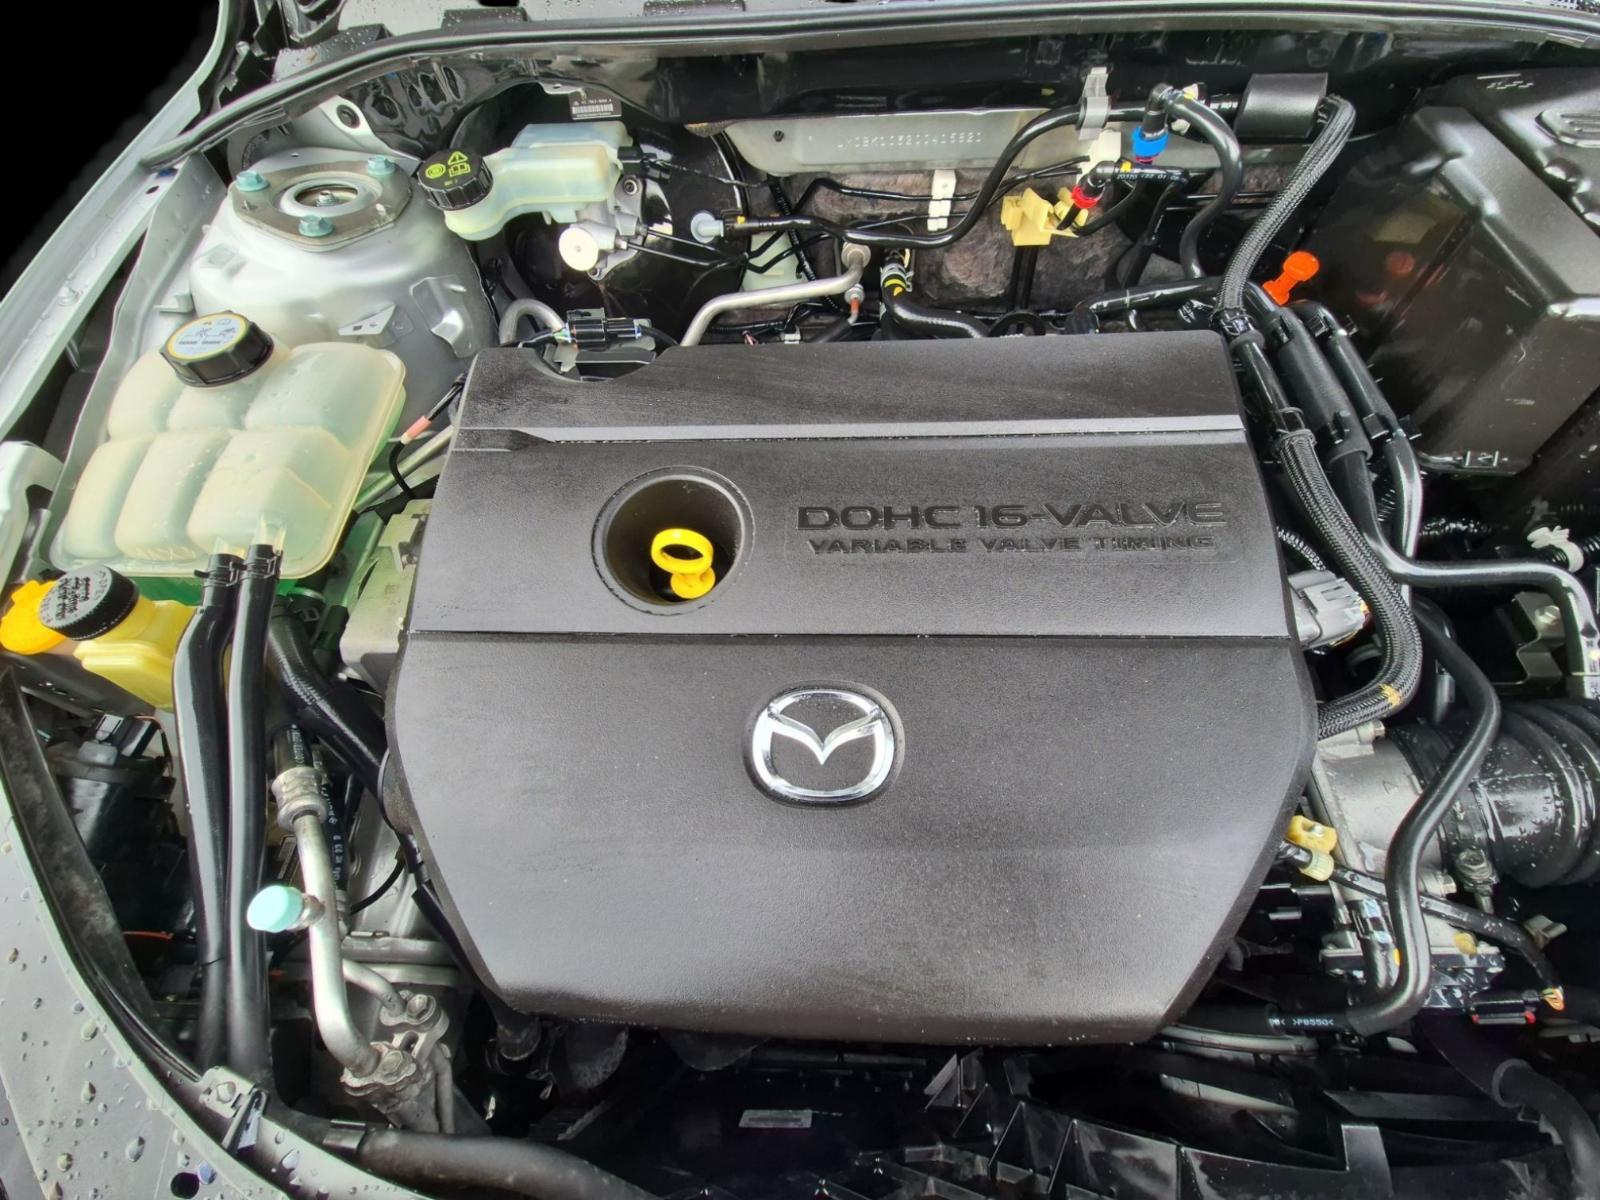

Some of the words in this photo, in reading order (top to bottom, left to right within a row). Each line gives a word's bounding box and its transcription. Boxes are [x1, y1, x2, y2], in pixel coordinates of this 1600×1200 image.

[797, 505, 962, 530] DOHC
[973, 502, 1228, 530] 16-VALVE
[807, 537, 968, 554] VARIABLE
[977, 536, 1082, 552] VALVE
[1090, 535, 1215, 551] TIMING
